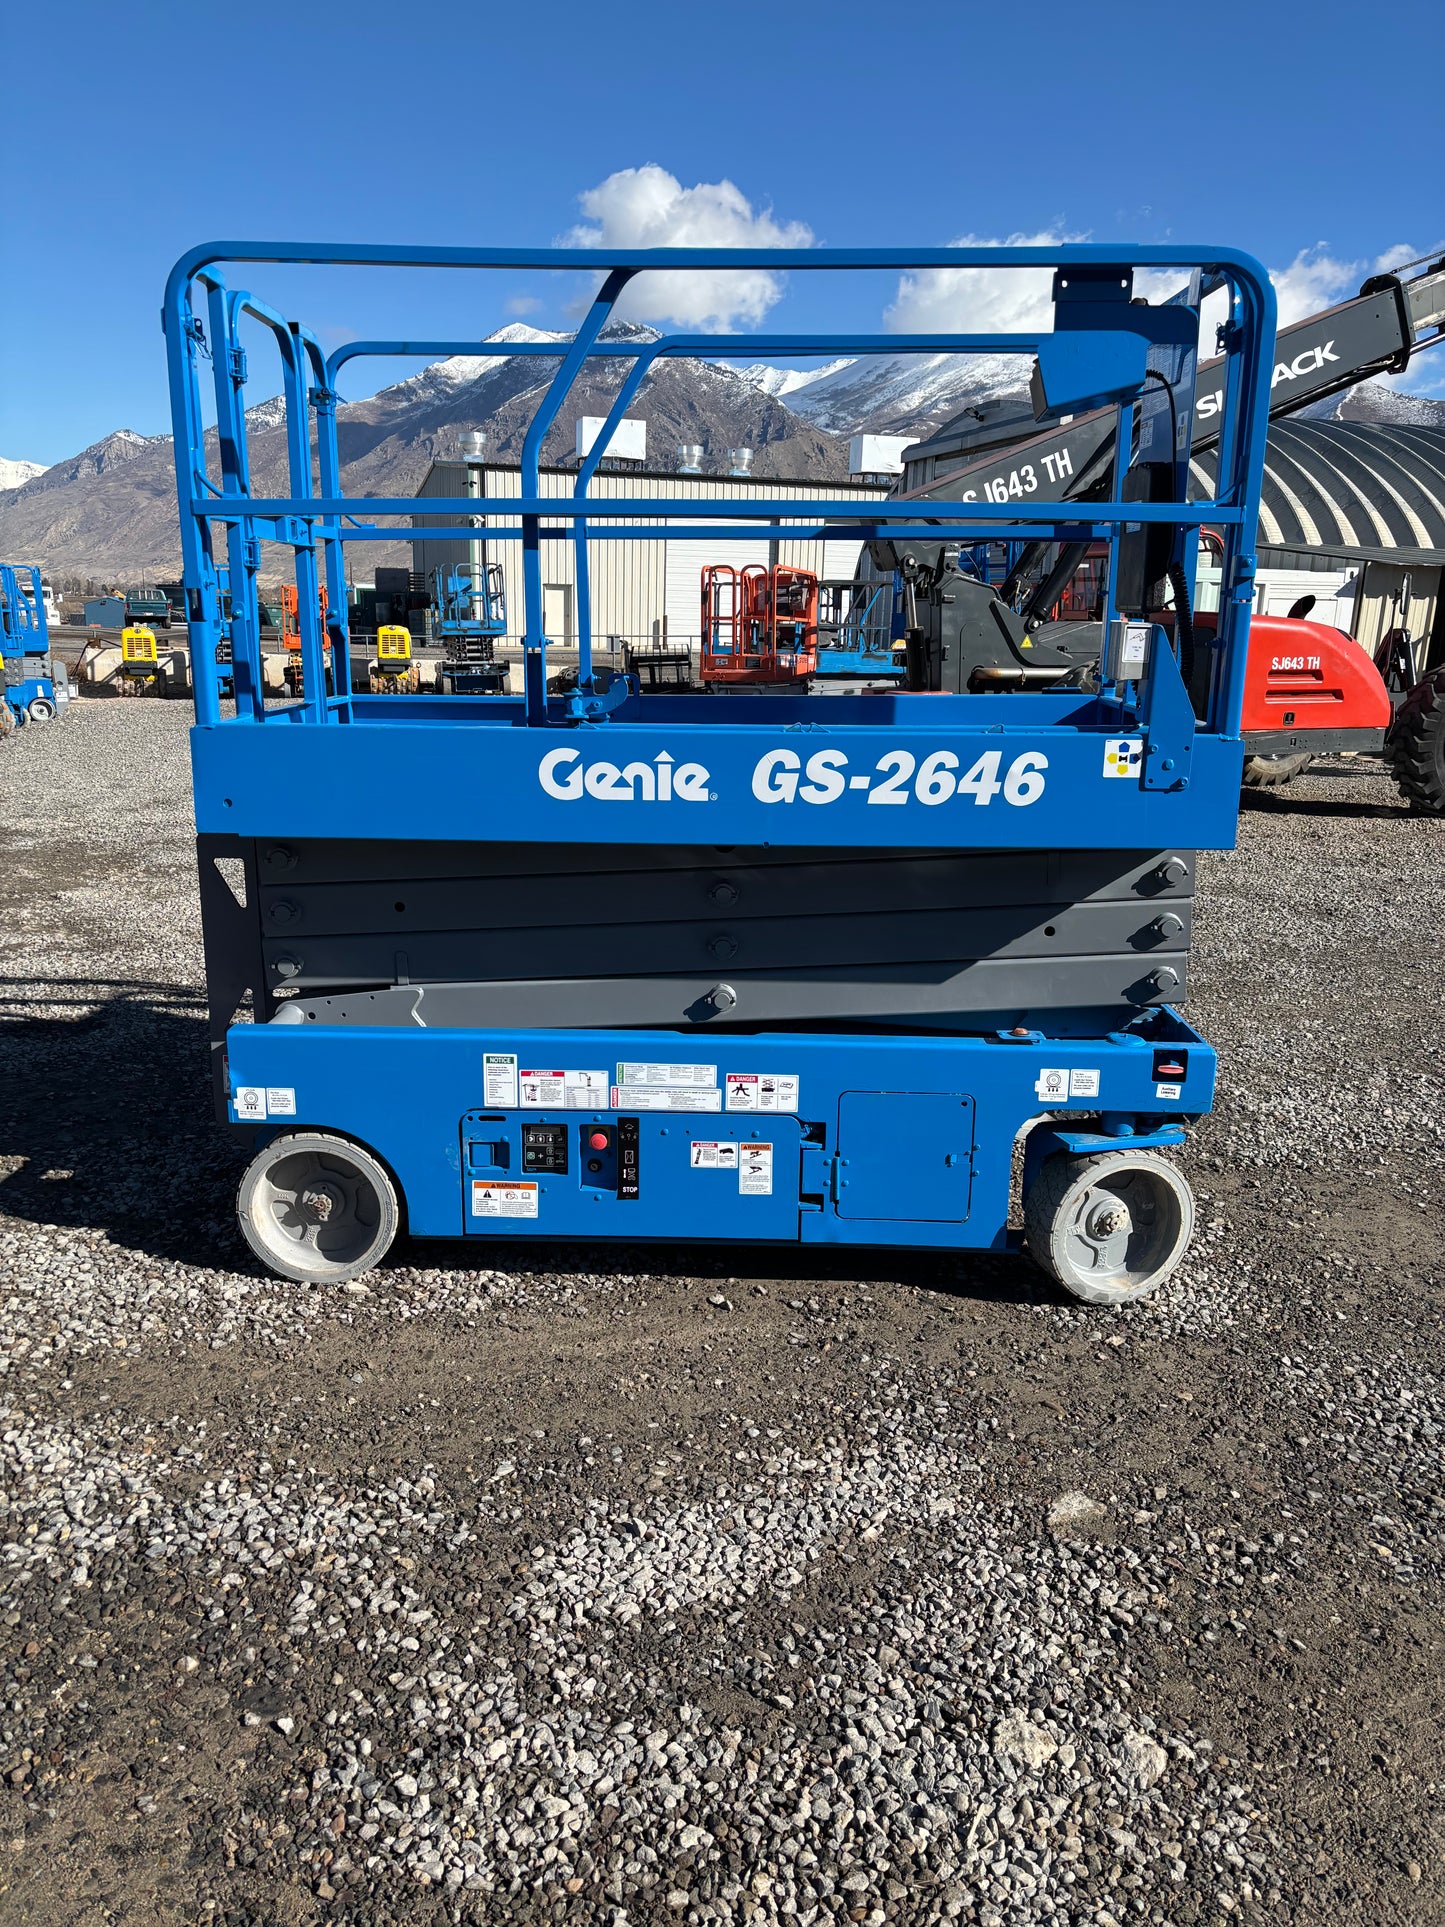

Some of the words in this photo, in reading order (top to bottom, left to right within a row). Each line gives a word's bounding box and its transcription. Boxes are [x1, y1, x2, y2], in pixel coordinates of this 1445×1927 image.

[1040, 448, 1074, 483] TH
[1271, 656, 1304, 670] SJ643
[1307, 656, 1320, 670] TH
[538, 748, 710, 801] Genie
[751, 749, 1048, 807] GS-2646
